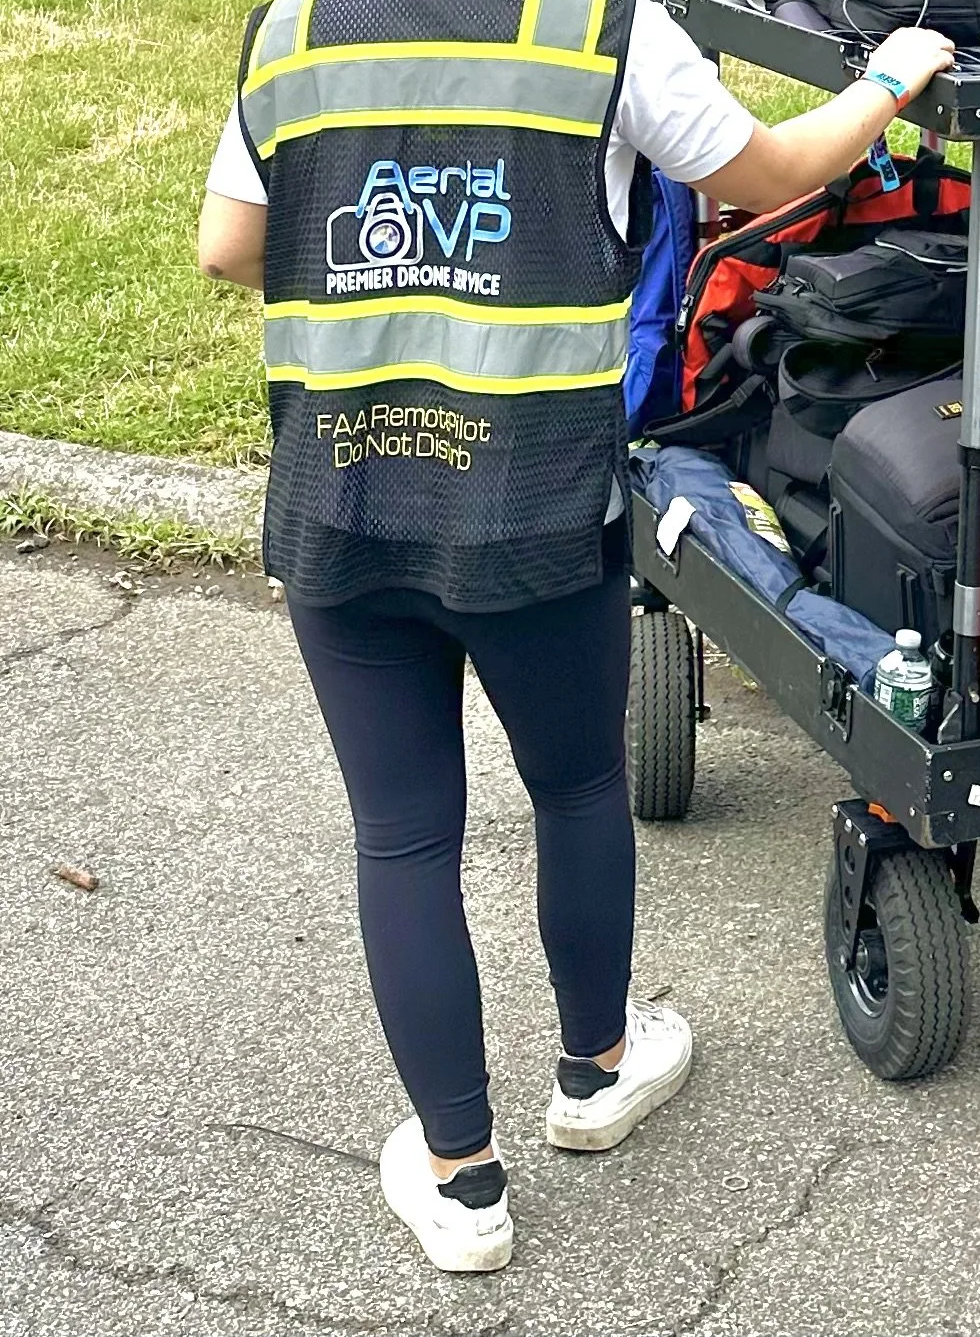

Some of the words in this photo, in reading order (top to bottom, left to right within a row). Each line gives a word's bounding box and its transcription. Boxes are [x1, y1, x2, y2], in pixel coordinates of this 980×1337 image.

[356, 158, 512, 218] Aerial
[423, 198, 512, 262] VP
[326, 269, 393, 295] PREMIER
[396, 266, 451, 289] DRONE
[316, 410, 368, 440] FAA
[333, 441, 362, 469] Do
[365, 434, 412, 460] Not
